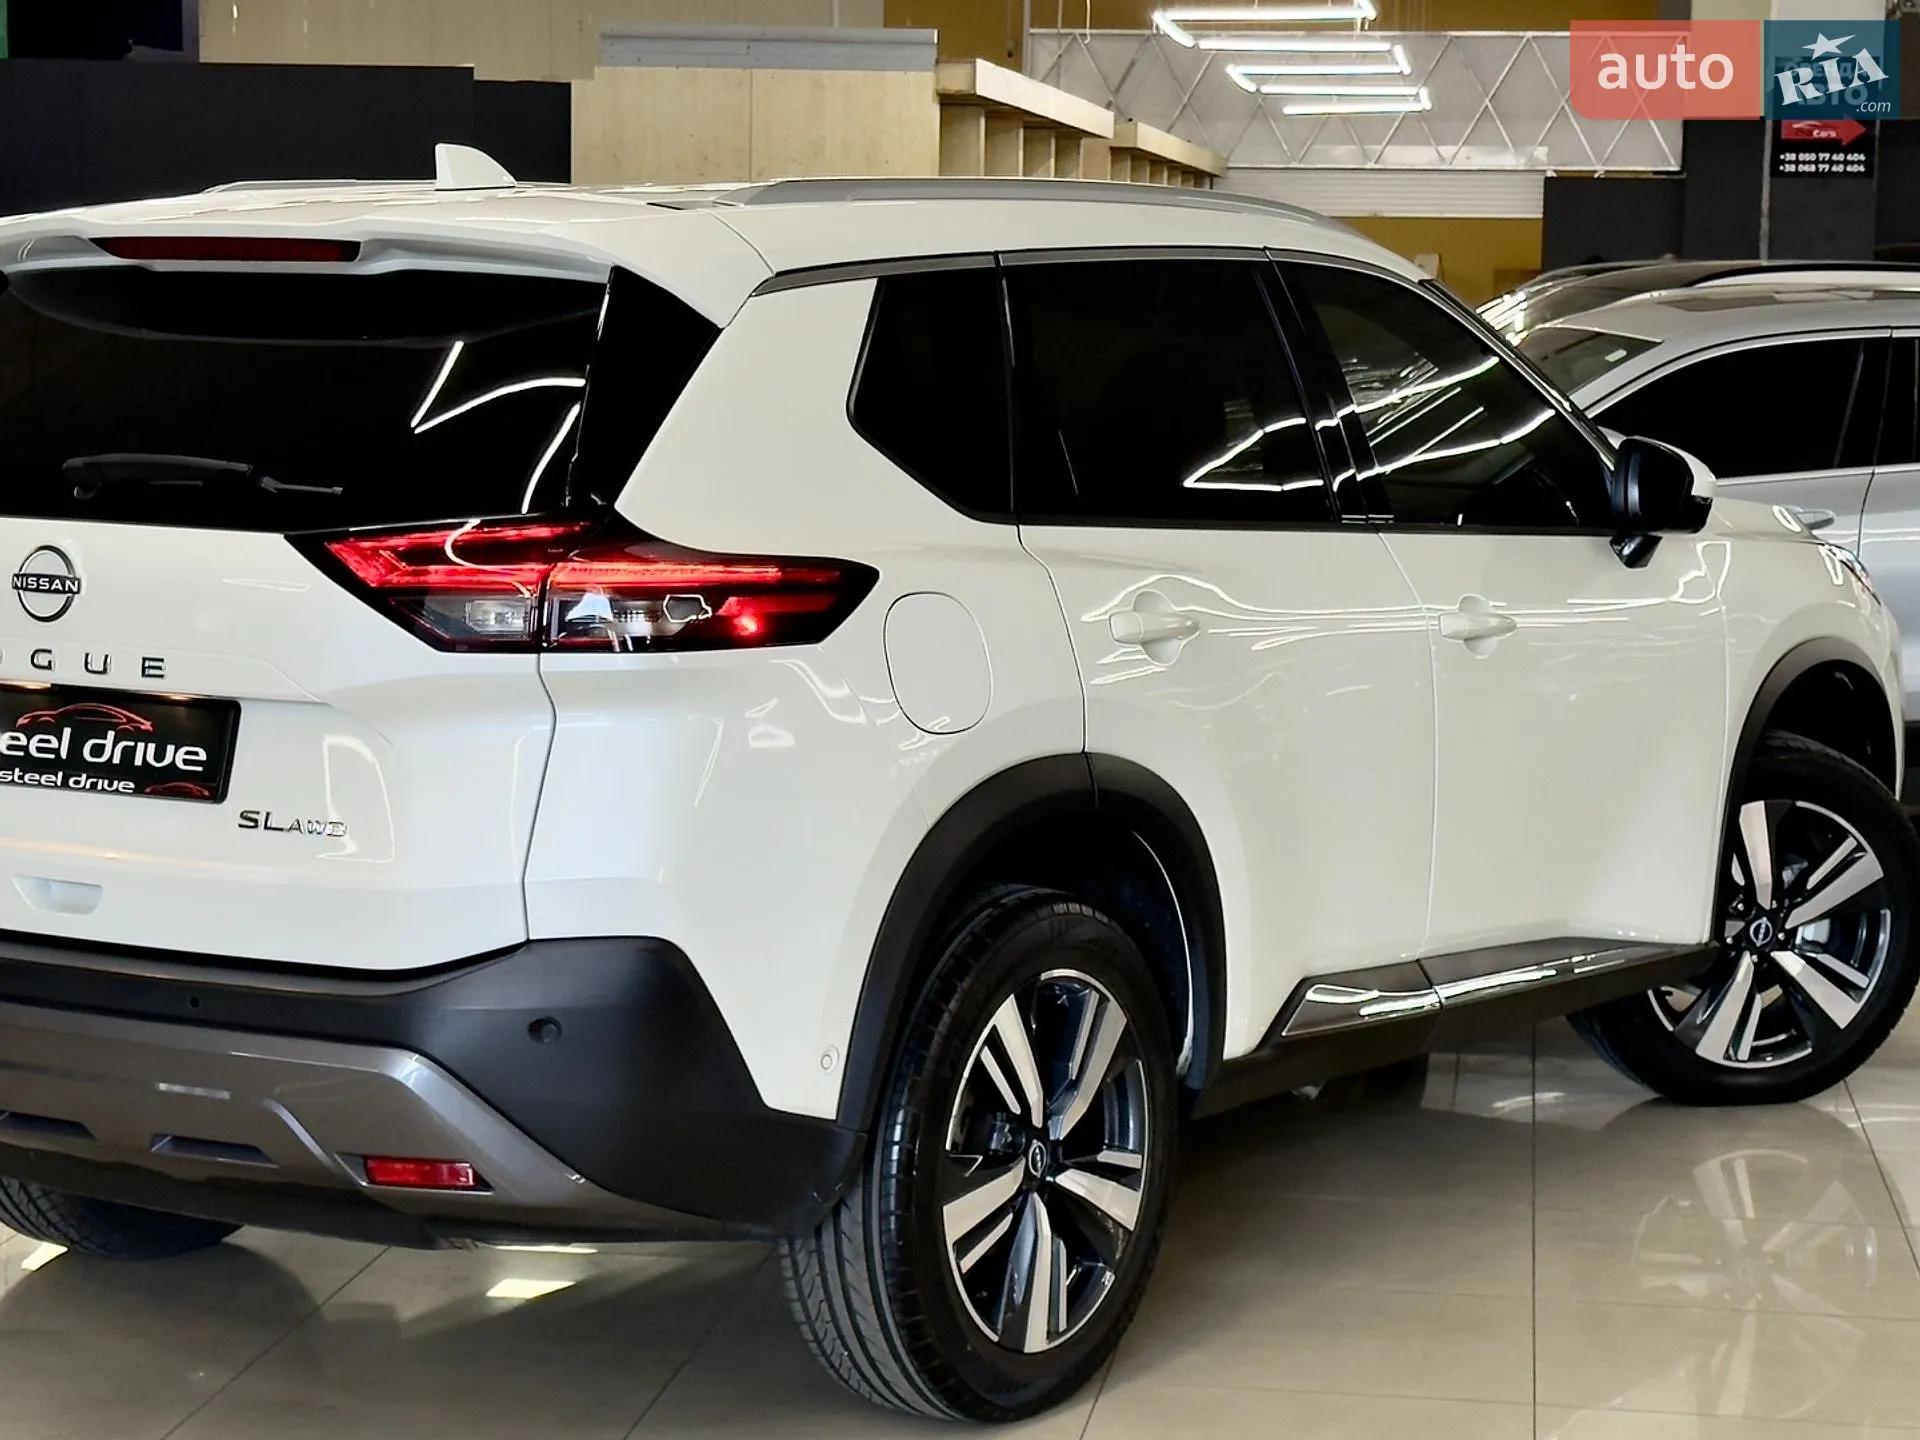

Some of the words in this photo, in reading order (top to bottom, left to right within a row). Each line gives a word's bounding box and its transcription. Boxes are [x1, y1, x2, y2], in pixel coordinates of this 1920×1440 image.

[13, 575, 79, 593] NISSAN
[0, 648, 165, 678] GUE
[82, 730, 207, 771] drive
[0, 767, 63, 787] steel
[68, 772, 136, 793] drive
